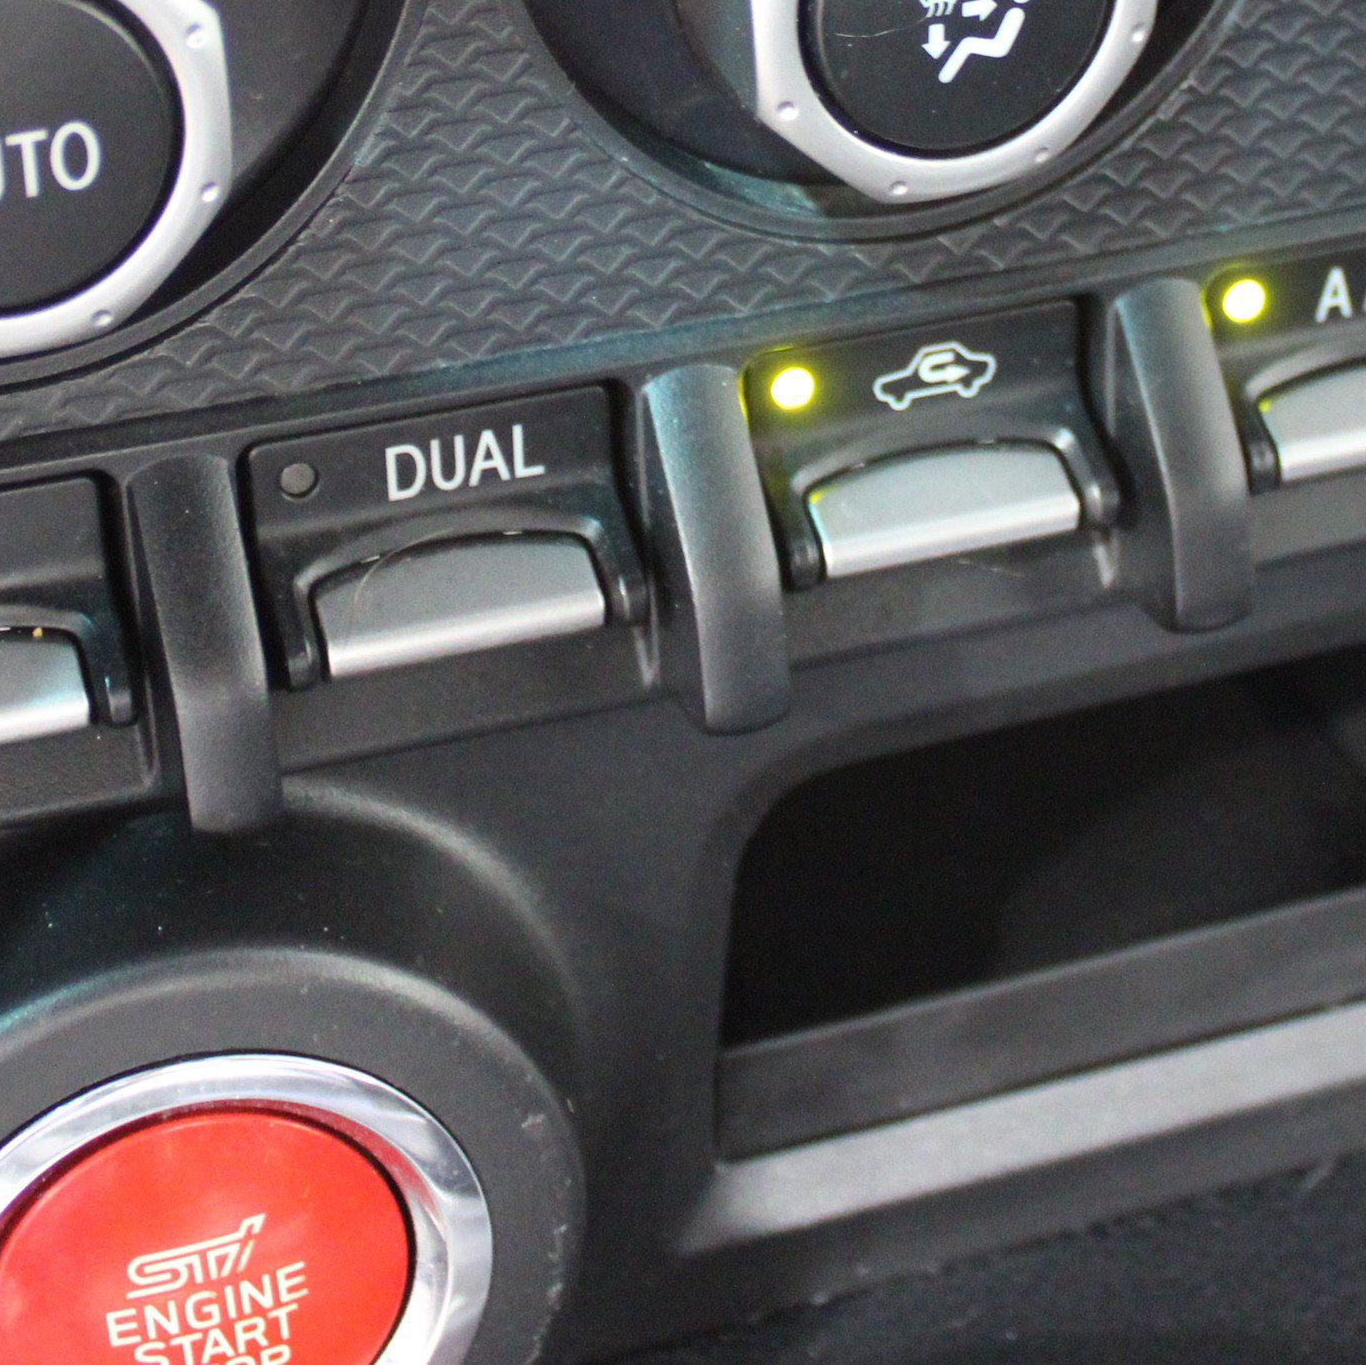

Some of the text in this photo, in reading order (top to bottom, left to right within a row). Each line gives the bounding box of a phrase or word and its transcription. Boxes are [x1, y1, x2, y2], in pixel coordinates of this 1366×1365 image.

[385, 424, 546, 502] DUAL
[105, 1261, 310, 1348] ENGINE
[133, 1303, 299, 1365] START
